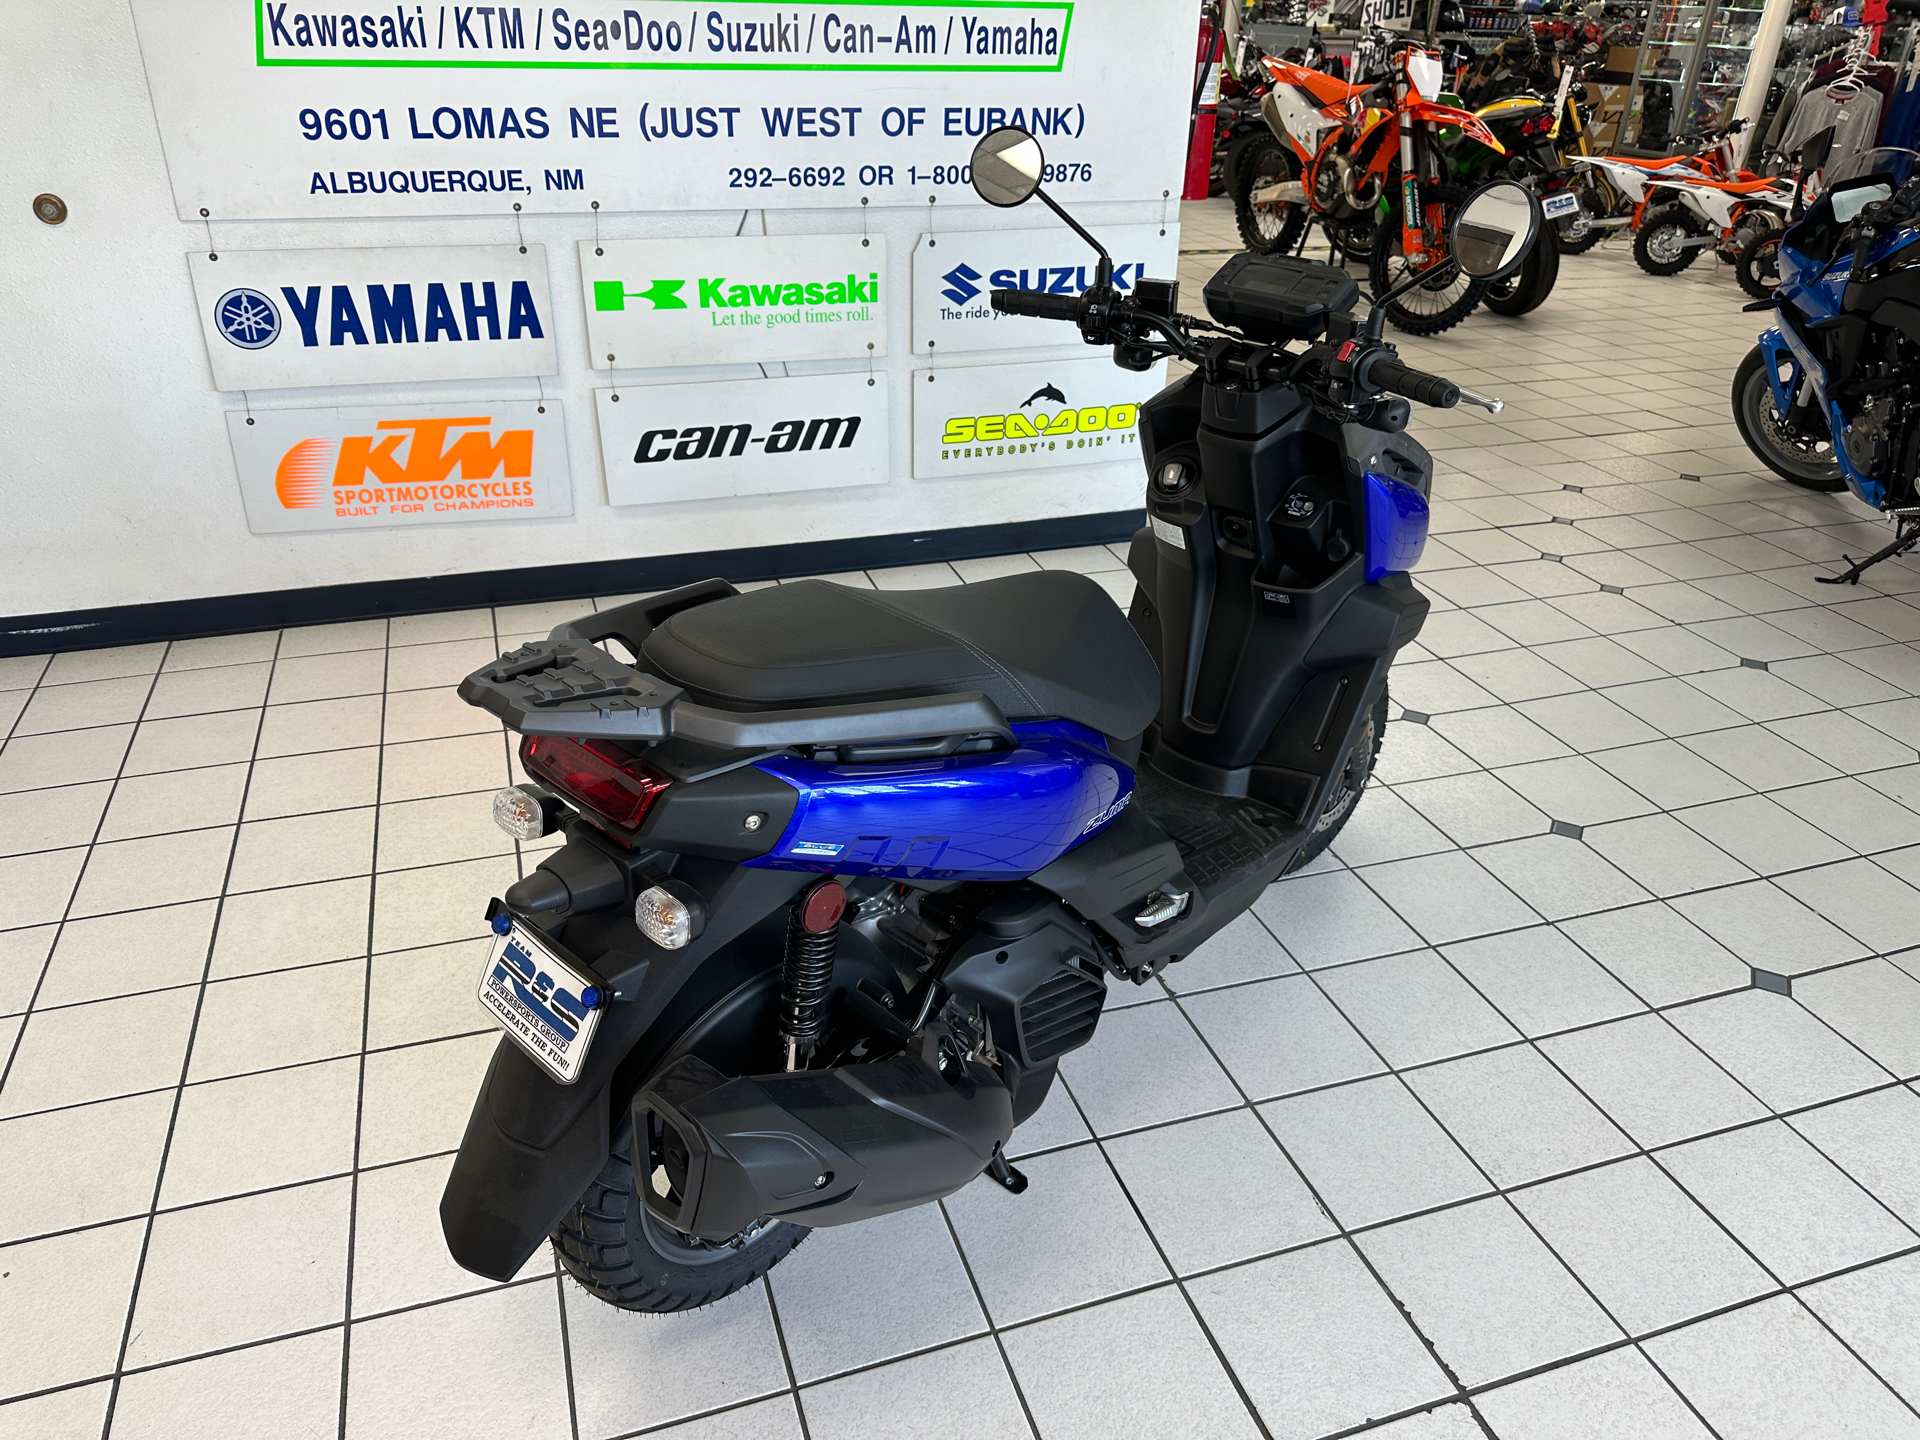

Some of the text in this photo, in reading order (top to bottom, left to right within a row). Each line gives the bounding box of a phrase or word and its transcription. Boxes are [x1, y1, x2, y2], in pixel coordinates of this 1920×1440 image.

[1363, 0, 1413, 25] SHOEI
[266, 3, 427, 49] Kawasaki
[454, 7, 524, 49] KTM
[707, 11, 799, 53] Suzuki
[824, 13, 936, 54] Can-Am
[961, 16, 1058, 56] Yamaha
[299, 103, 1085, 142] 9601 LOMAS NE (JUST WEST OF EUBANK)
[310, 169, 532, 196] ALBUQUERQUE,
[544, 169, 584, 190] NM
[729, 166, 846, 188] 292-6692
[859, 165, 894, 186] OR
[698, 272, 878, 308] Kawasaki
[990, 263, 1144, 293] SUZUKI
[280, 280, 545, 347] YAMAHA
[711, 306, 874, 328] Let the good times roll.
[940, 307, 963, 320] The
[966, 305, 990, 319] ride
[332, 416, 534, 487] KTM
[942, 442, 1055, 460] EVERYBODY'S
[333, 481, 534, 506] SPORTMOTORCYCLES
[335, 498, 535, 517] BUILT FOR CHAMPIONS
[510, 936, 532, 958] TEAM
[490, 979, 566, 1049] POWERSPORTS GROUP
[483, 990, 570, 1072] ACCELERATE THE FUN!!
